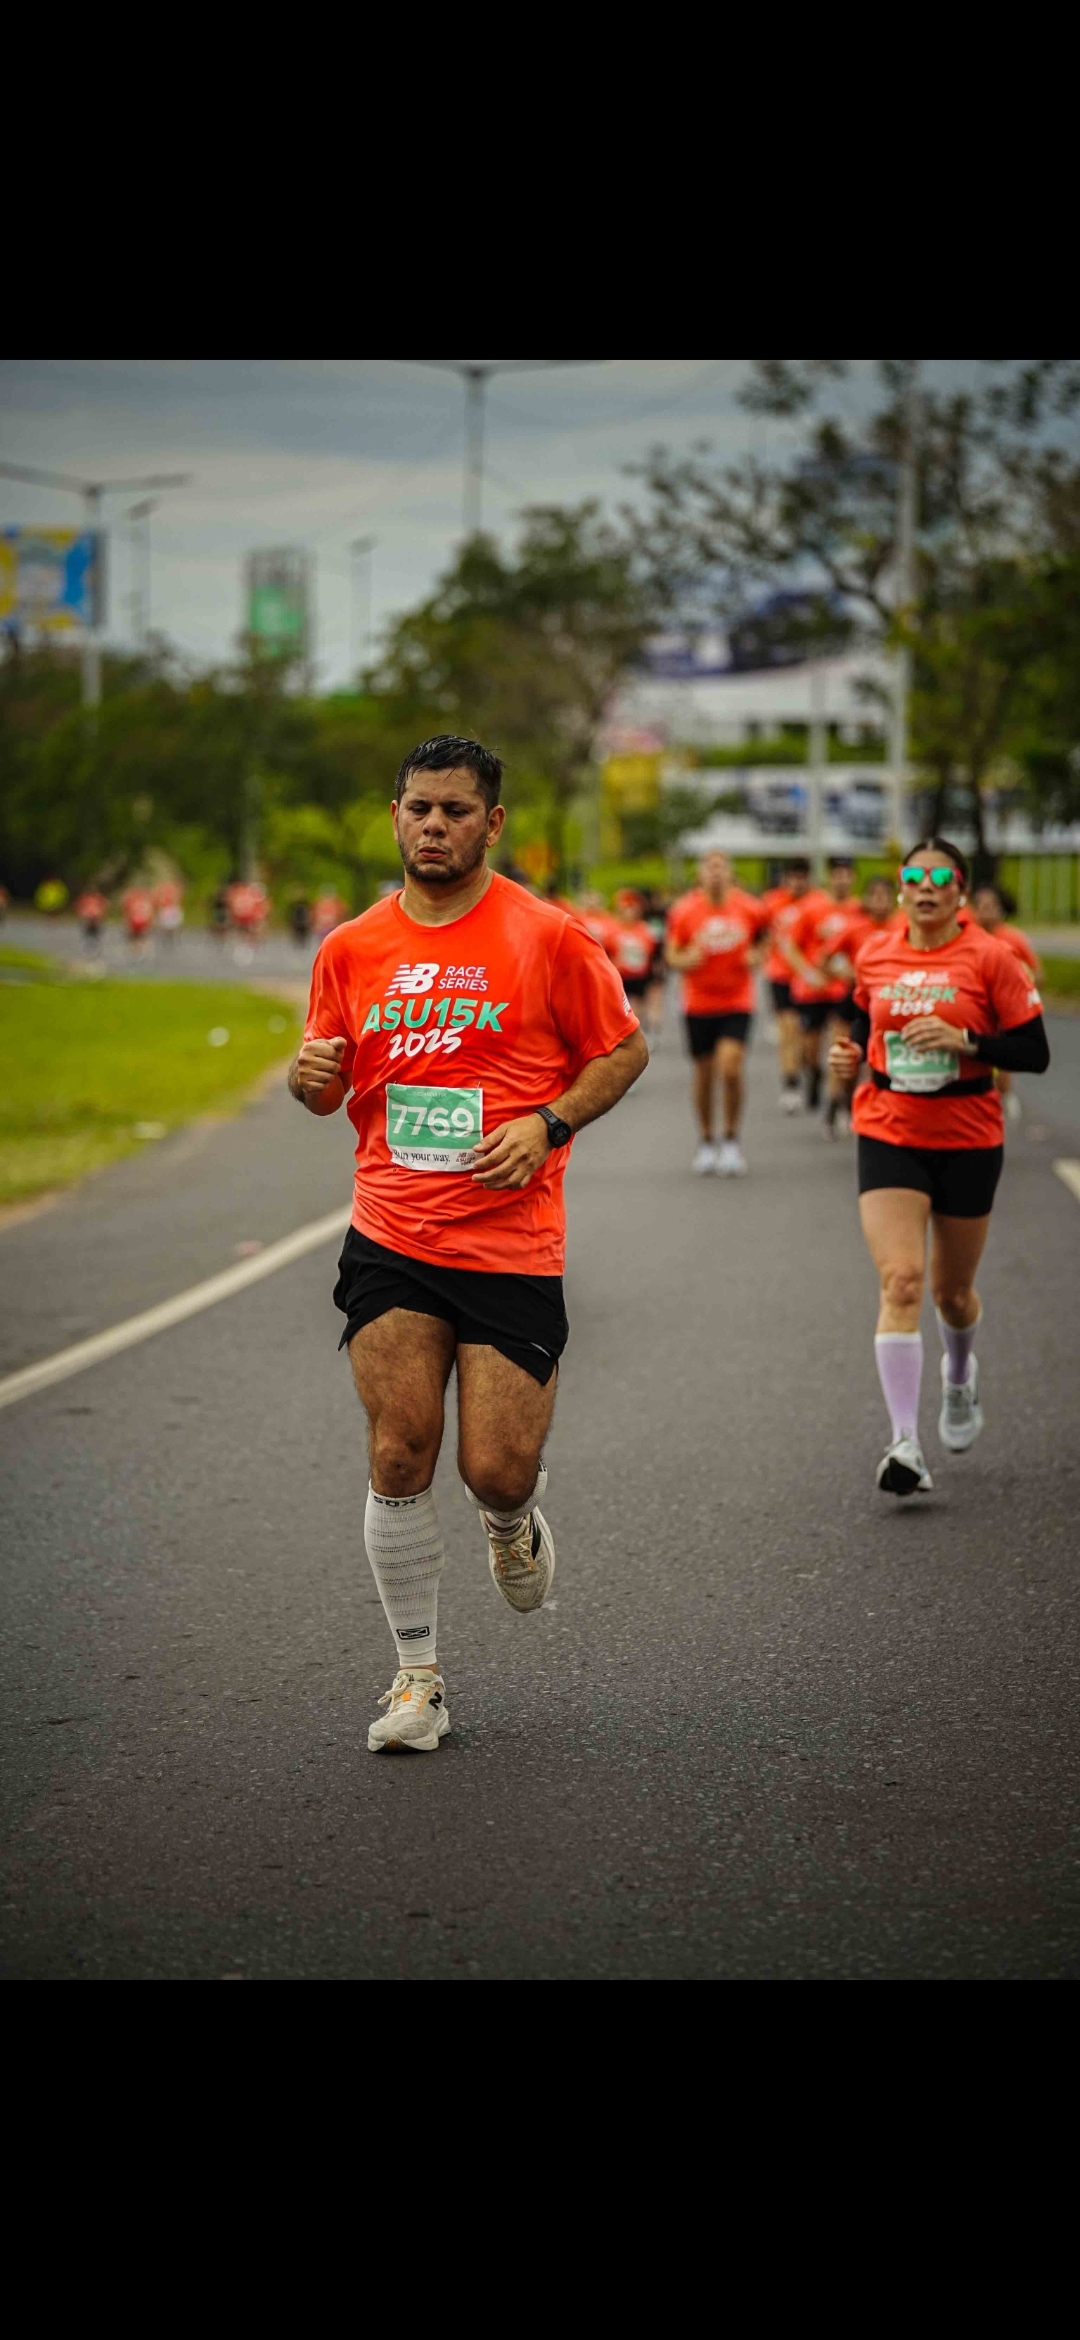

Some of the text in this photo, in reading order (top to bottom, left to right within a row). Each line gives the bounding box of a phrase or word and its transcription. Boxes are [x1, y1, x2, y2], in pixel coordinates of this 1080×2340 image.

[445, 966, 486, 978] RACE
[438, 978, 489, 991] SERIES
[361, 997, 510, 1035] ASU15K
[389, 1025, 467, 1060] 2025
[391, 1103, 475, 1138] 7769
[411, 1152, 430, 1163] your
[432, 1153, 451, 1164] way.
